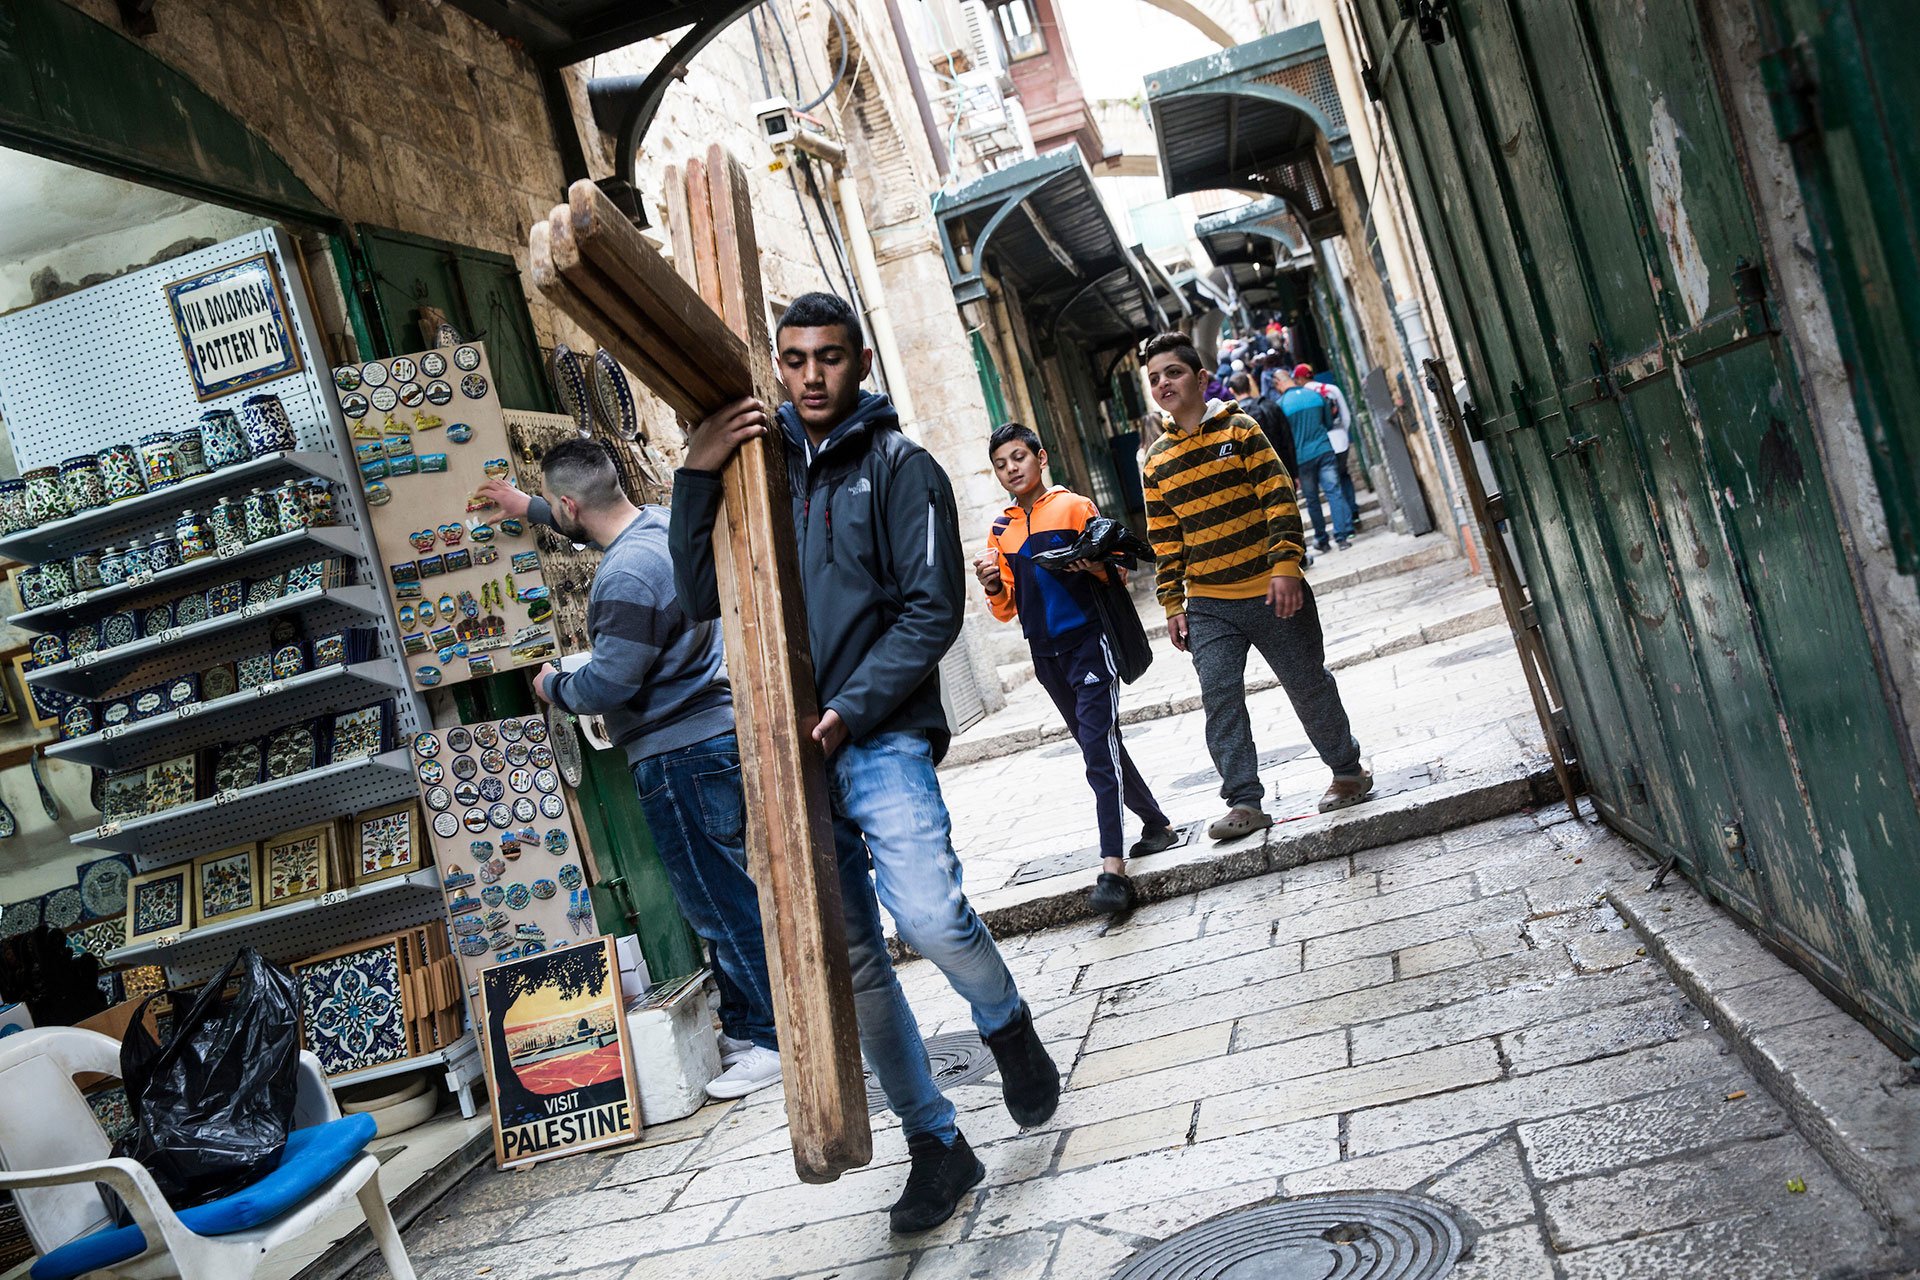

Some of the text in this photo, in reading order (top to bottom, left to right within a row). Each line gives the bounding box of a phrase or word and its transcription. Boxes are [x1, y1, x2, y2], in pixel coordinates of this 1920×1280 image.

[183, 282, 269, 333] VIA DOLOROSA
[197, 322, 279, 374] POTTERY 26
[219, 544, 234, 557] 45
[64, 593, 79, 607] 25
[240, 606, 252, 618] 10
[159, 631, 171, 642] 10
[74, 656, 85, 667] 10
[258, 685, 270, 696] 10
[177, 706, 190, 719] 10
[102, 728, 113, 740] 10
[215, 790, 226, 806] 15
[96, 825, 108, 838] 15
[323, 894, 336, 905] 30
[157, 936, 170, 948] 30
[544, 1092, 579, 1115] VISIT
[502, 1103, 631, 1159] PALESTINE
